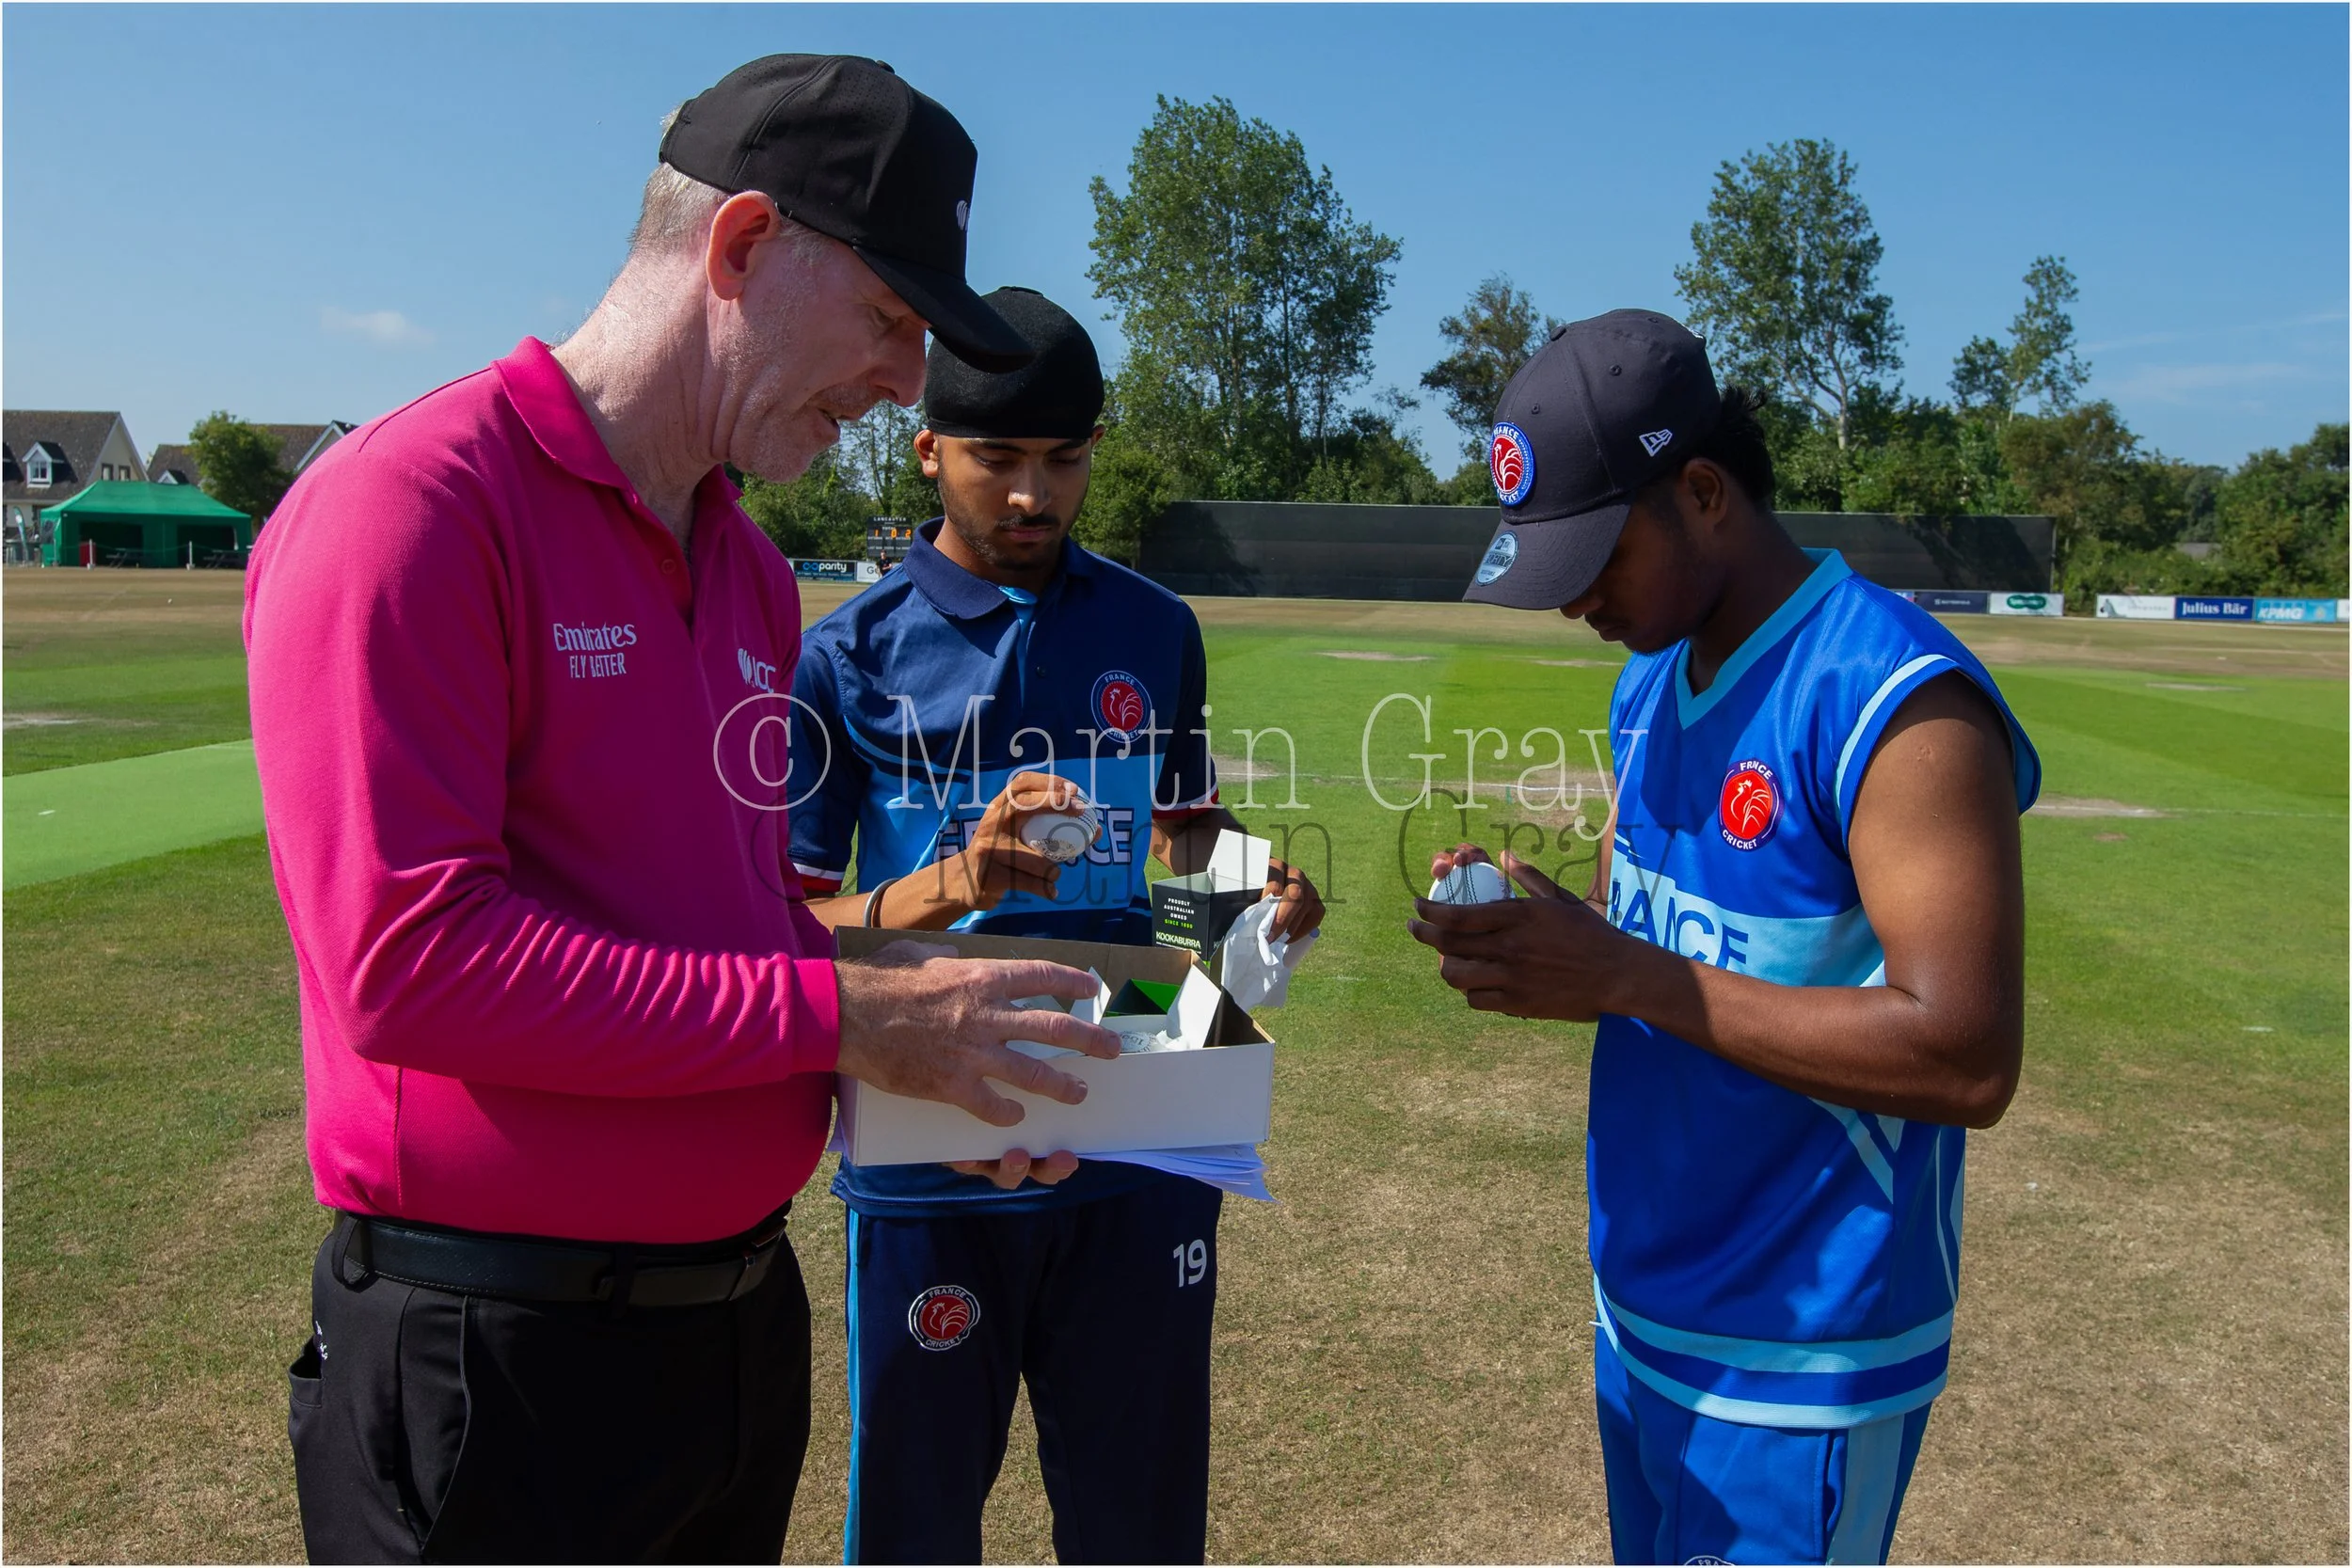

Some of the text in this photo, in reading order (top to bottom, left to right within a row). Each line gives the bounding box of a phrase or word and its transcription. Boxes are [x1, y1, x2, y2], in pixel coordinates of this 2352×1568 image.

[2182, 602, 2220, 615] Julius
[2223, 602, 2248, 614] Bär
[2258, 607, 2303, 620] KPMG
[552, 621, 638, 651] Emirates
[569, 652, 627, 678] FLY BETTER
[1104, 673, 1135, 686] FRANCE
[1723, 829, 1757, 850] CRICKET
[1164, 905, 1194, 914] AUSTRALIAN
[1155, 931, 1201, 949] KOOKABURRA
[1173, 1239, 1207, 1288] 19
[929, 1288, 966, 1298] FRANCE
[925, 1335, 961, 1348] CRICKET
